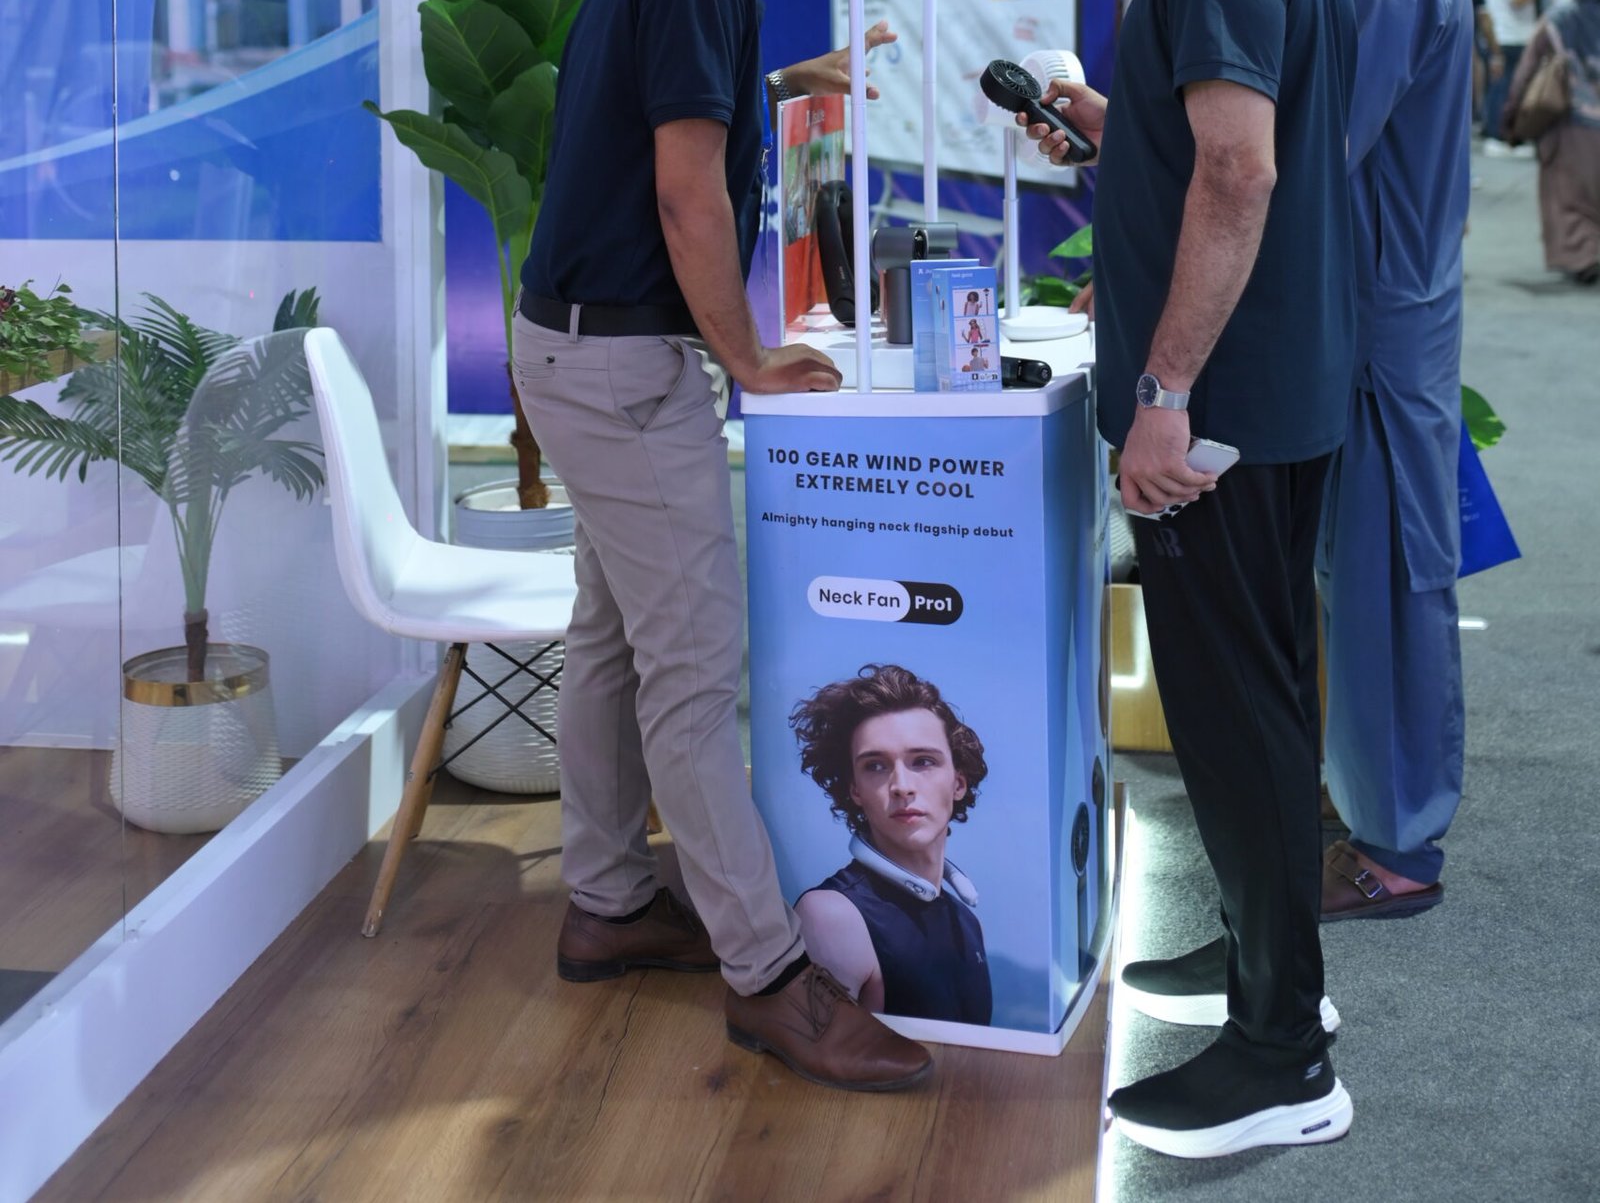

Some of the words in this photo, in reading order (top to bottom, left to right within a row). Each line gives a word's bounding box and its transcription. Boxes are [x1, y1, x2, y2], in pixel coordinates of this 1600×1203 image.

[768, 448, 800, 465] 100
[806, 451, 859, 469] GEAR
[866, 454, 922, 472] WIND
[929, 458, 1005, 477] POWER
[795, 473, 909, 495] EXTREMELY
[916, 480, 975, 499] COOL
[761, 511, 818, 529] Almighty
[821, 516, 875, 533] hanging
[879, 521, 910, 532] neck
[914, 522, 970, 539] flagship
[973, 526, 1014, 538] debut
[819, 588, 862, 606] Neck
[868, 592, 900, 608] Fan
[915, 595, 952, 612] Pro1
